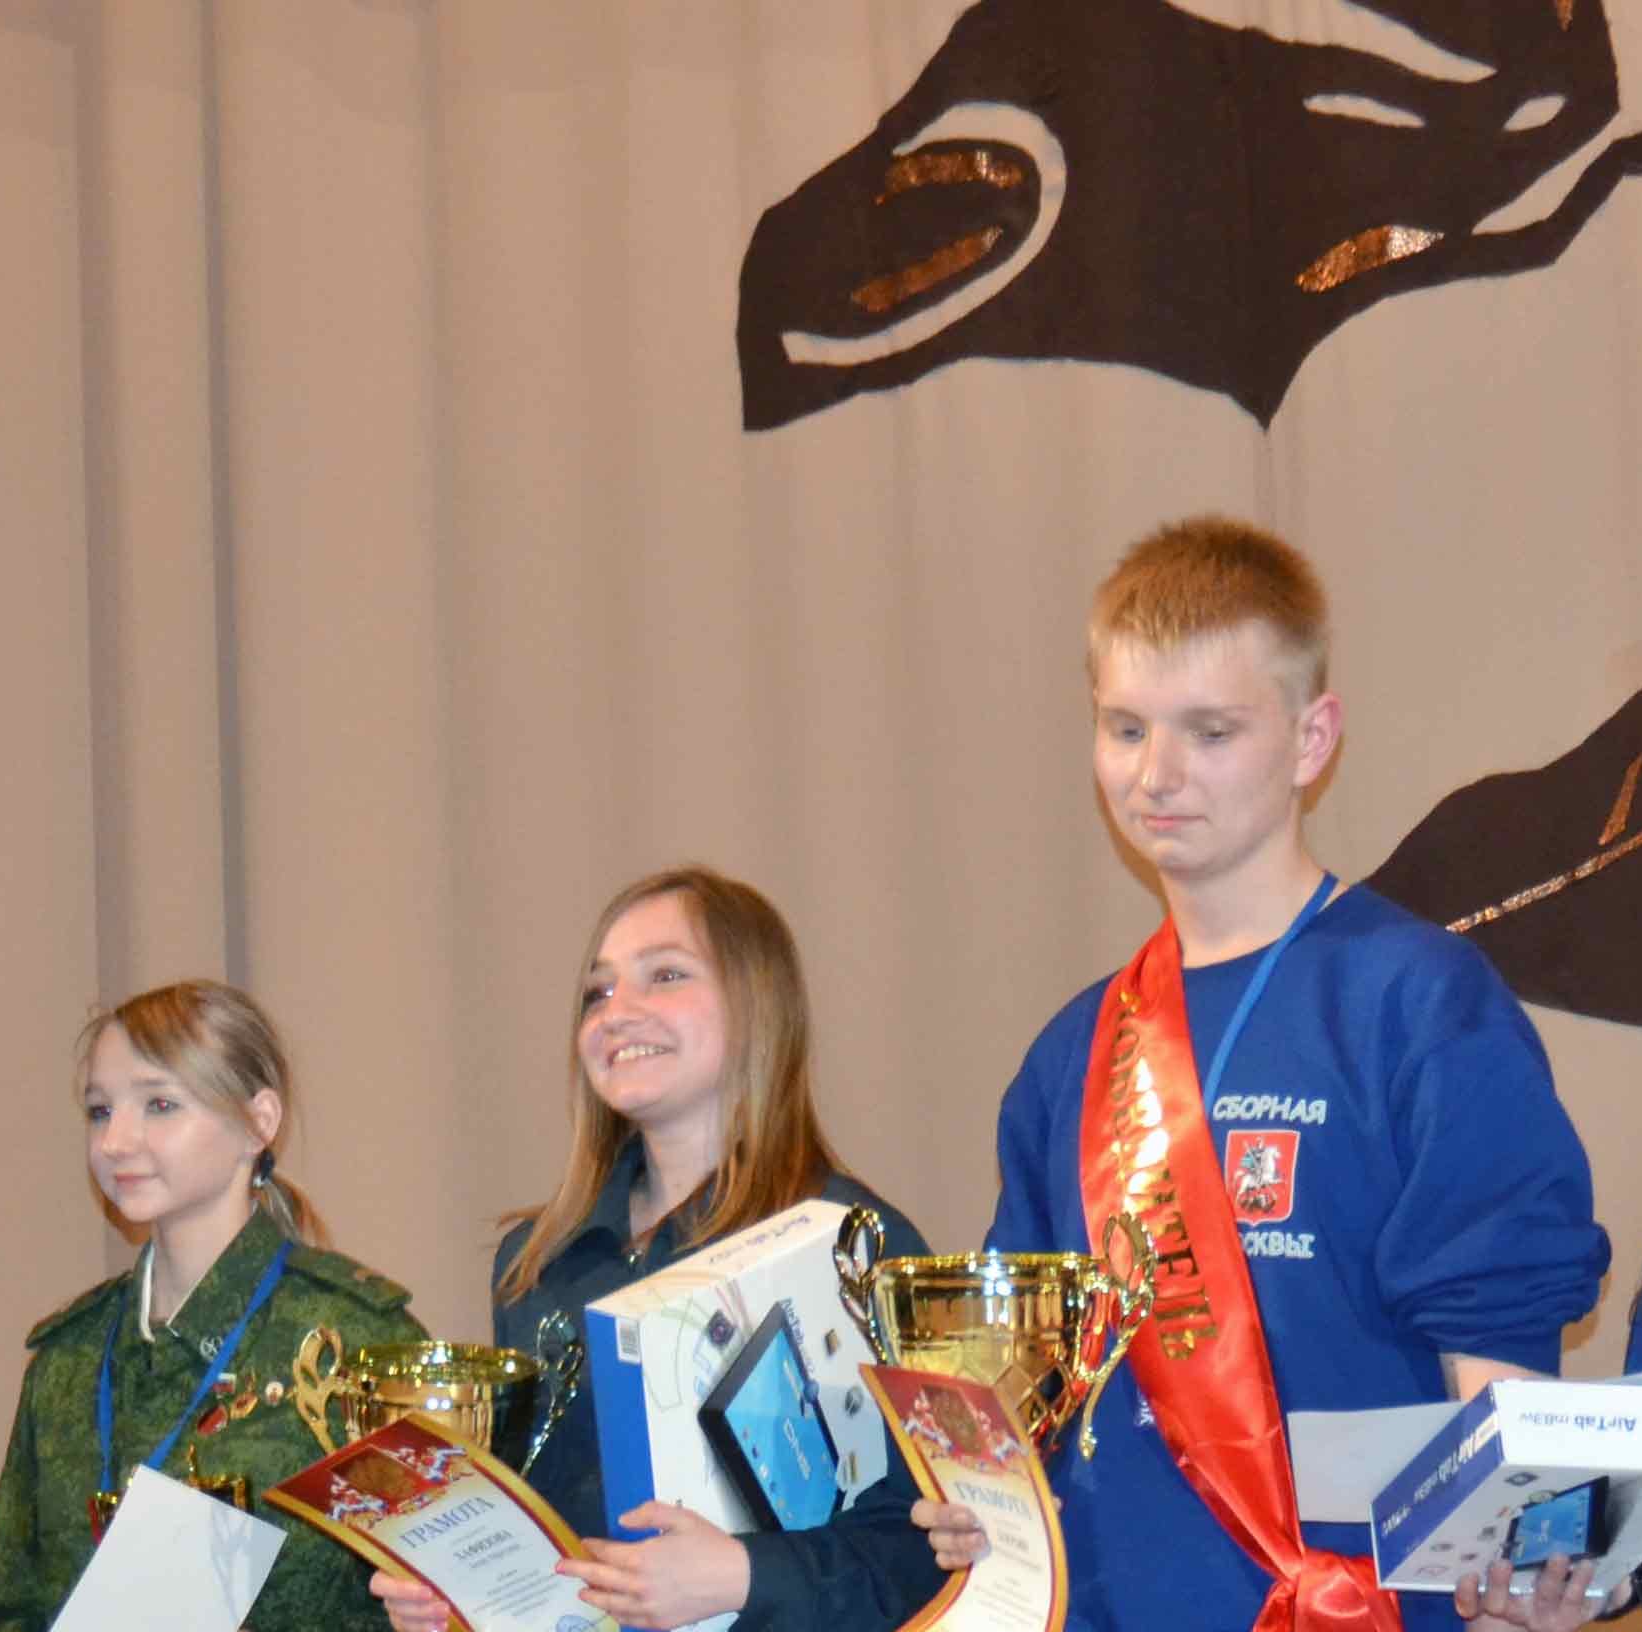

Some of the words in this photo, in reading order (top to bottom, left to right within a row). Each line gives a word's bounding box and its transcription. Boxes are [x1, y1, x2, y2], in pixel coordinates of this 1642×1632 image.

[1212, 1095, 1327, 1125] СБОРНАЯ
[1238, 1230, 1316, 1259] СКВЫ
[1574, 1414, 1637, 1432] AirTab
[399, 1495, 496, 1549] ГРАМОТА
